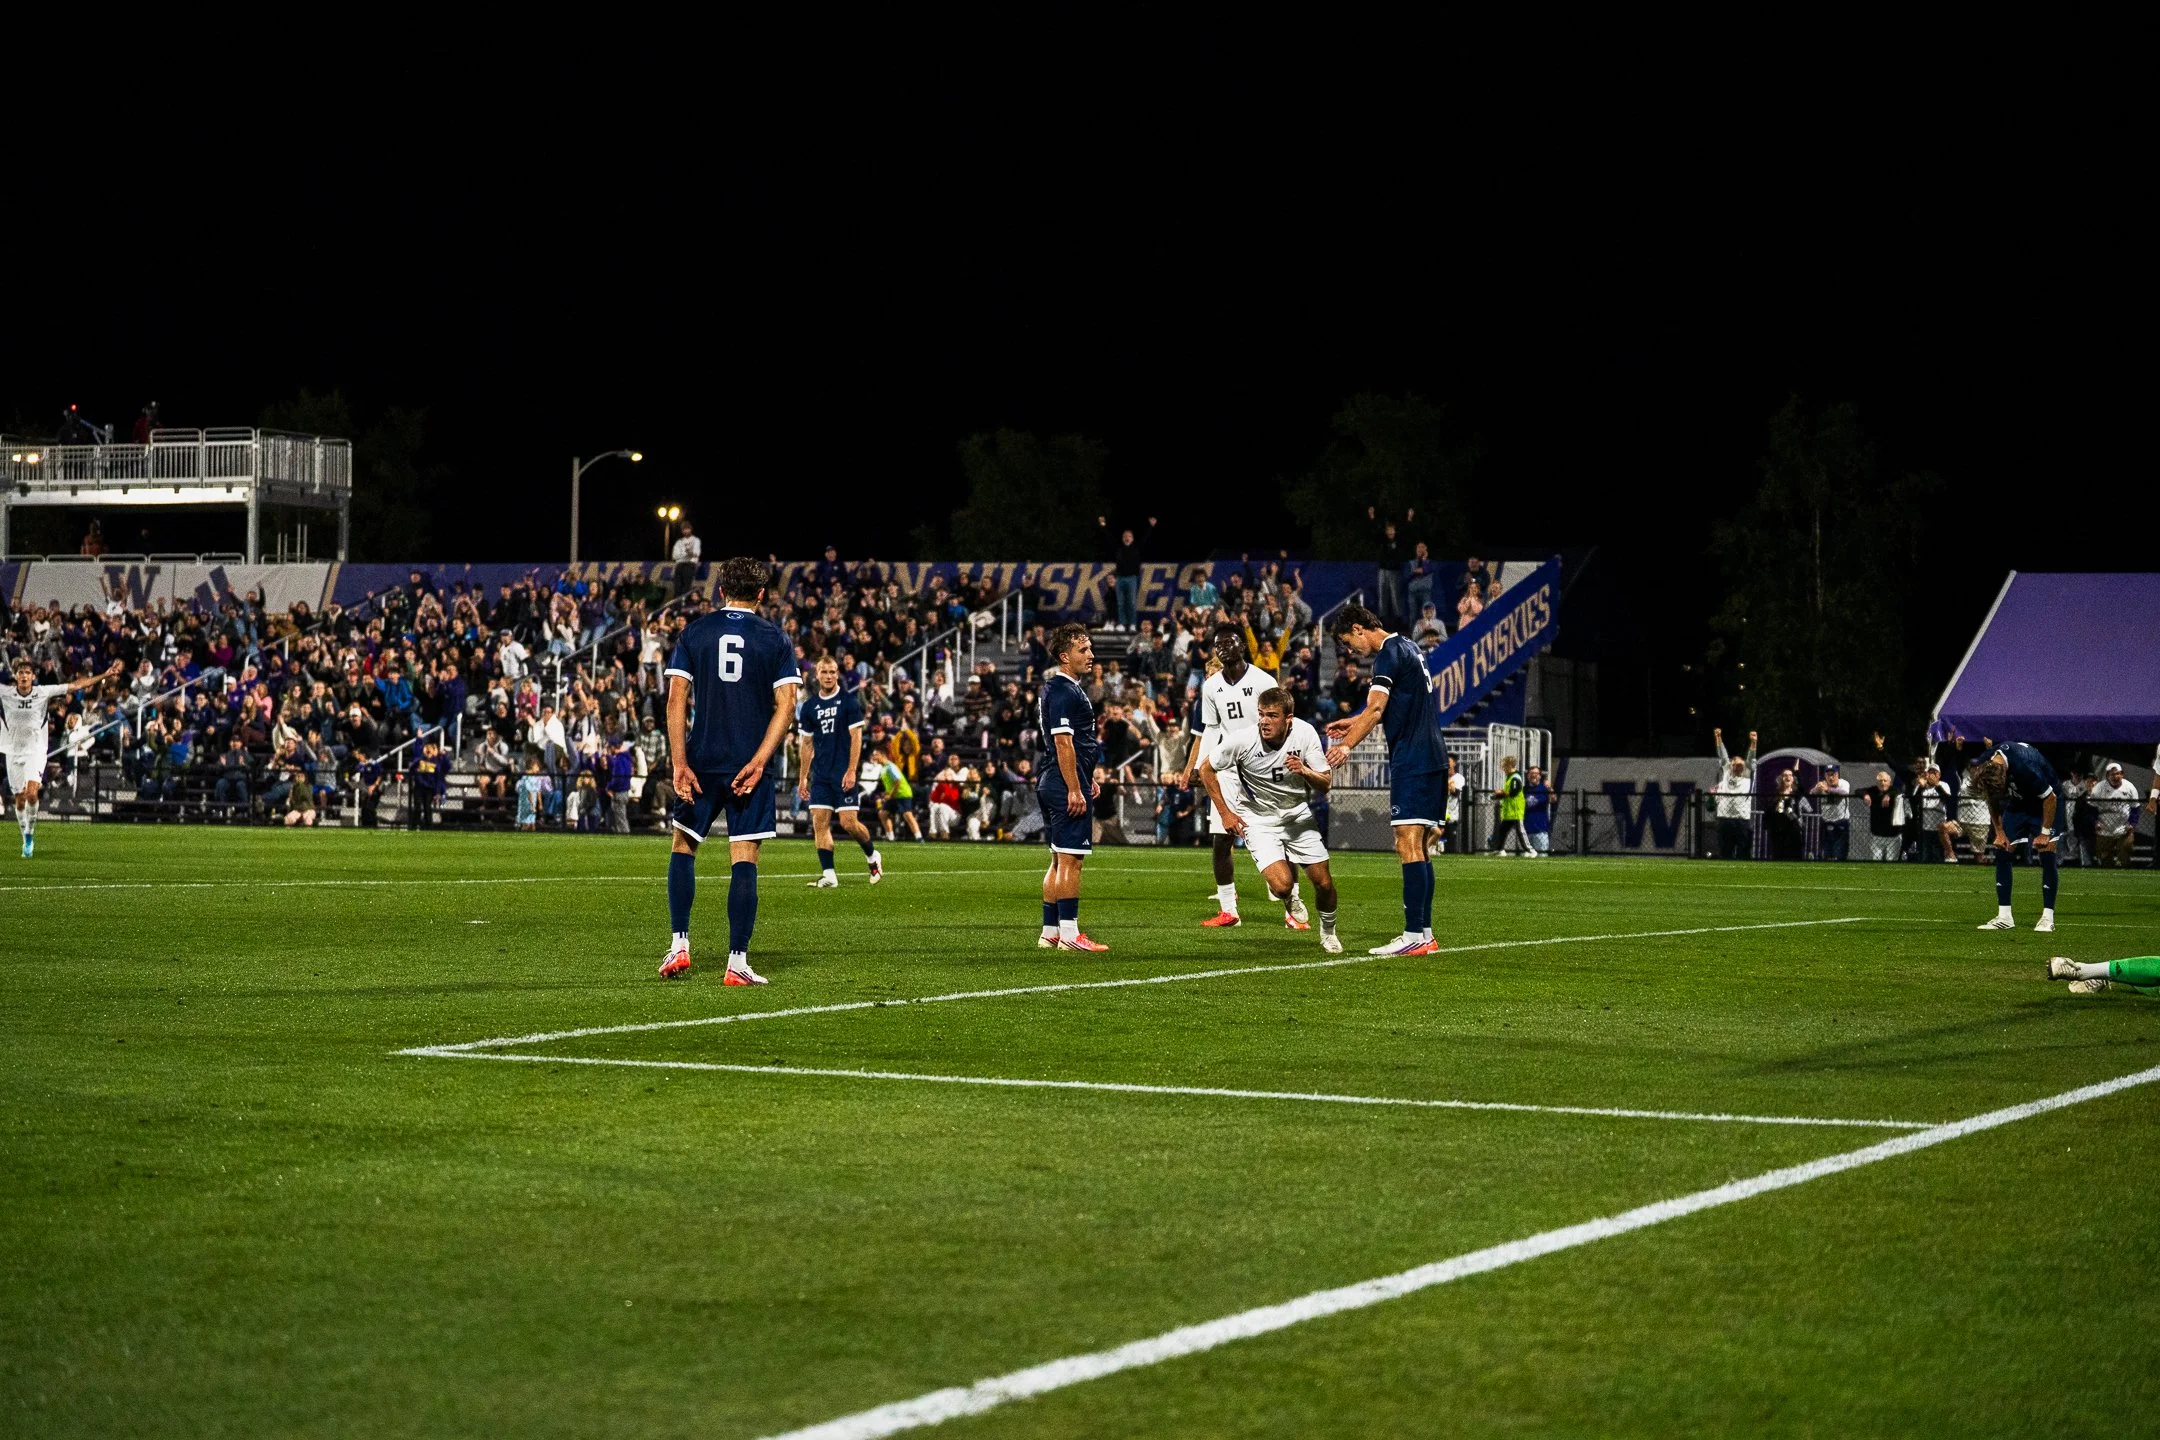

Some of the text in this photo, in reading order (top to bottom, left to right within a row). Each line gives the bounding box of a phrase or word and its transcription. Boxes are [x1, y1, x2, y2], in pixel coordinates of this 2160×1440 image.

[568, 561, 1215, 612] WASHGN HUSKES
[1472, 584, 1550, 688] HUSKIES
[718, 634, 745, 682] 6
[1242, 687, 1253, 696] W
[817, 706, 837, 719] PSU
[1227, 701, 1244, 719] 21
[821, 718, 835, 734] 27
[1271, 767, 1284, 783] 6
[1602, 781, 1696, 848] W
